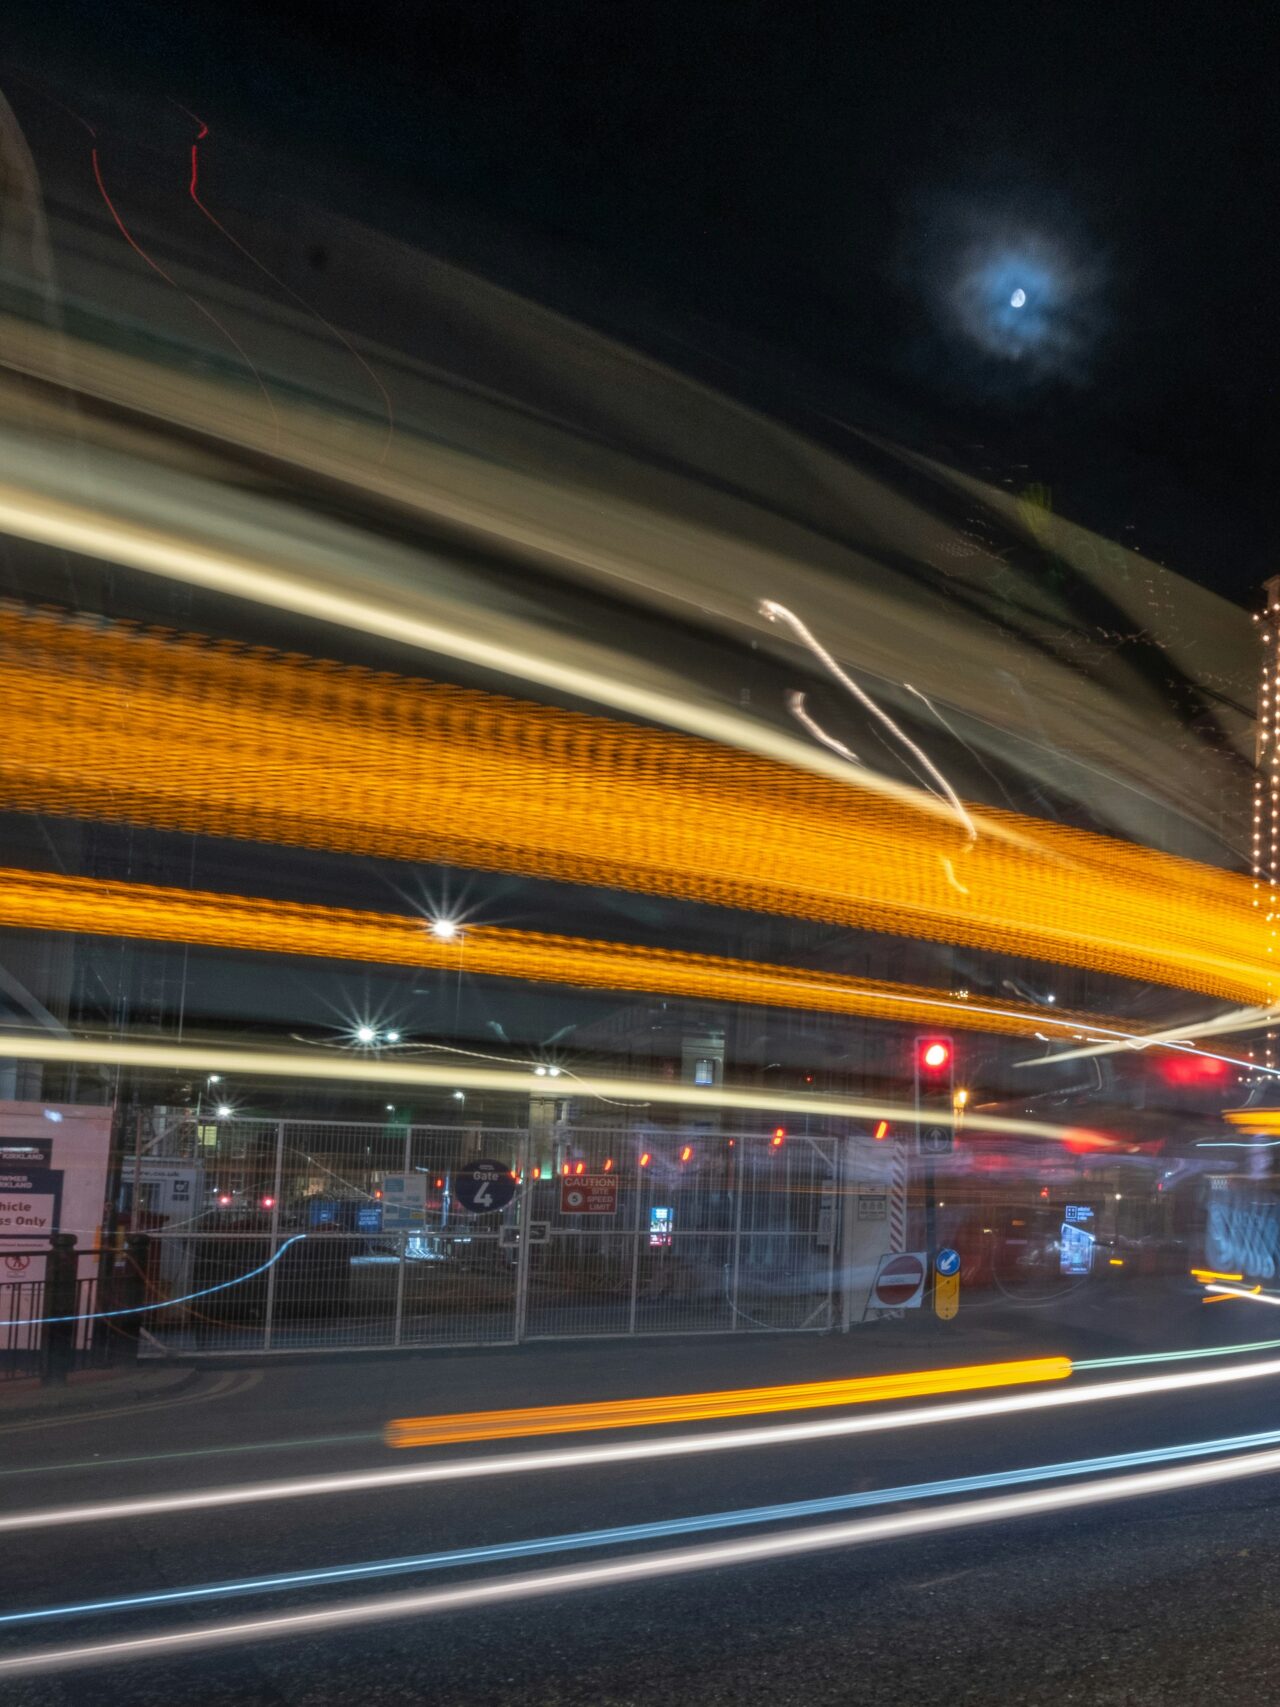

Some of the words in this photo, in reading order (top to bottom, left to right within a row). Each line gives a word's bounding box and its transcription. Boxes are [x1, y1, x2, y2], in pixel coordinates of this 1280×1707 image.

[473, 1171, 499, 1181] Gate
[564, 1178, 615, 1187] CAUTION
[473, 1182, 493, 1208] 4
[587, 1195, 614, 1203] SPEED
[16, 1216, 47, 1227] Only
